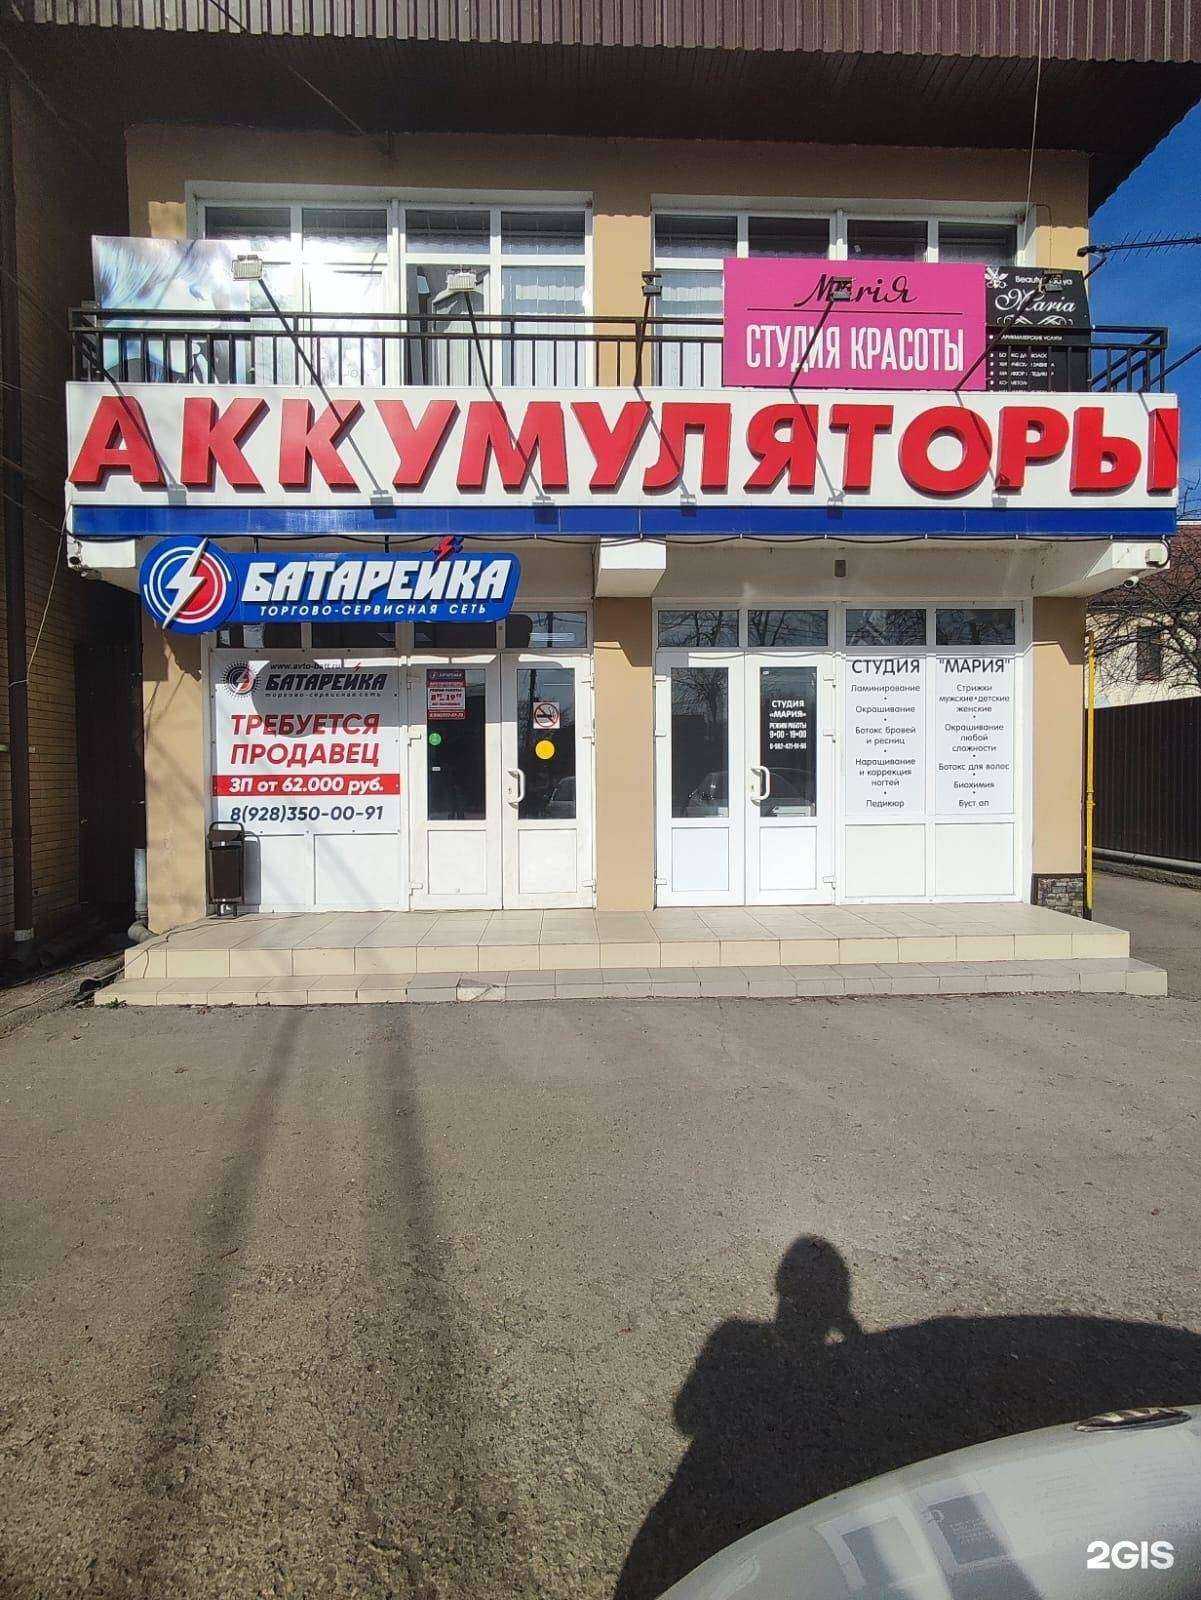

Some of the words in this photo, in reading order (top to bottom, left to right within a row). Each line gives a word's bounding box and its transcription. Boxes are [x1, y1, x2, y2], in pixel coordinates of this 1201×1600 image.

[746, 324, 841, 373] СТУДИЯ
[851, 326, 964, 372] КРАСОТЫ
[68, 396, 1178, 495] АККУМУЛЯТОРЫ
[241, 538, 512, 602] БАТАРЕЙКА
[260, 605, 438, 617] ТОРГОВО-СЕРВИСНАЯ
[449, 603, 487, 615] СЕТЬ
[851, 659, 920, 675] СТУДИЯ
[939, 659, 1010, 673] "МАРИЯ"
[265, 664, 388, 691] БАТАРЕЙКА
[851, 684, 921, 692] Ламинирование
[956, 684, 992, 693] Стрижки
[771, 699, 805, 708] СТУДИЯ
[855, 705, 916, 714] Окрашивание
[231, 713, 380, 736] ТРЕБУЕТСЯ
[944, 723, 1004, 732] Окрашивание
[855, 726, 882, 734] Ботокс
[885, 726, 916, 735] бровей
[874, 738, 905, 746] ресниц
[960, 734, 989, 742] любой
[230, 743, 379, 768] ПРОДАВЕЦ
[855, 758, 916, 766] Наращивание
[938, 763, 966, 771] Ботокс
[229, 777, 253, 793] ЗП
[257, 781, 278, 792] от
[282, 777, 344, 792] 62.000
[348, 777, 384, 795] руб.
[871, 778, 900, 786] ногтей
[953, 780, 995, 788] Биохимия
[866, 799, 905, 808] Педикюр
[958, 799, 977, 807] Буст
[230, 805, 384, 823] 8(928)350-00-91
